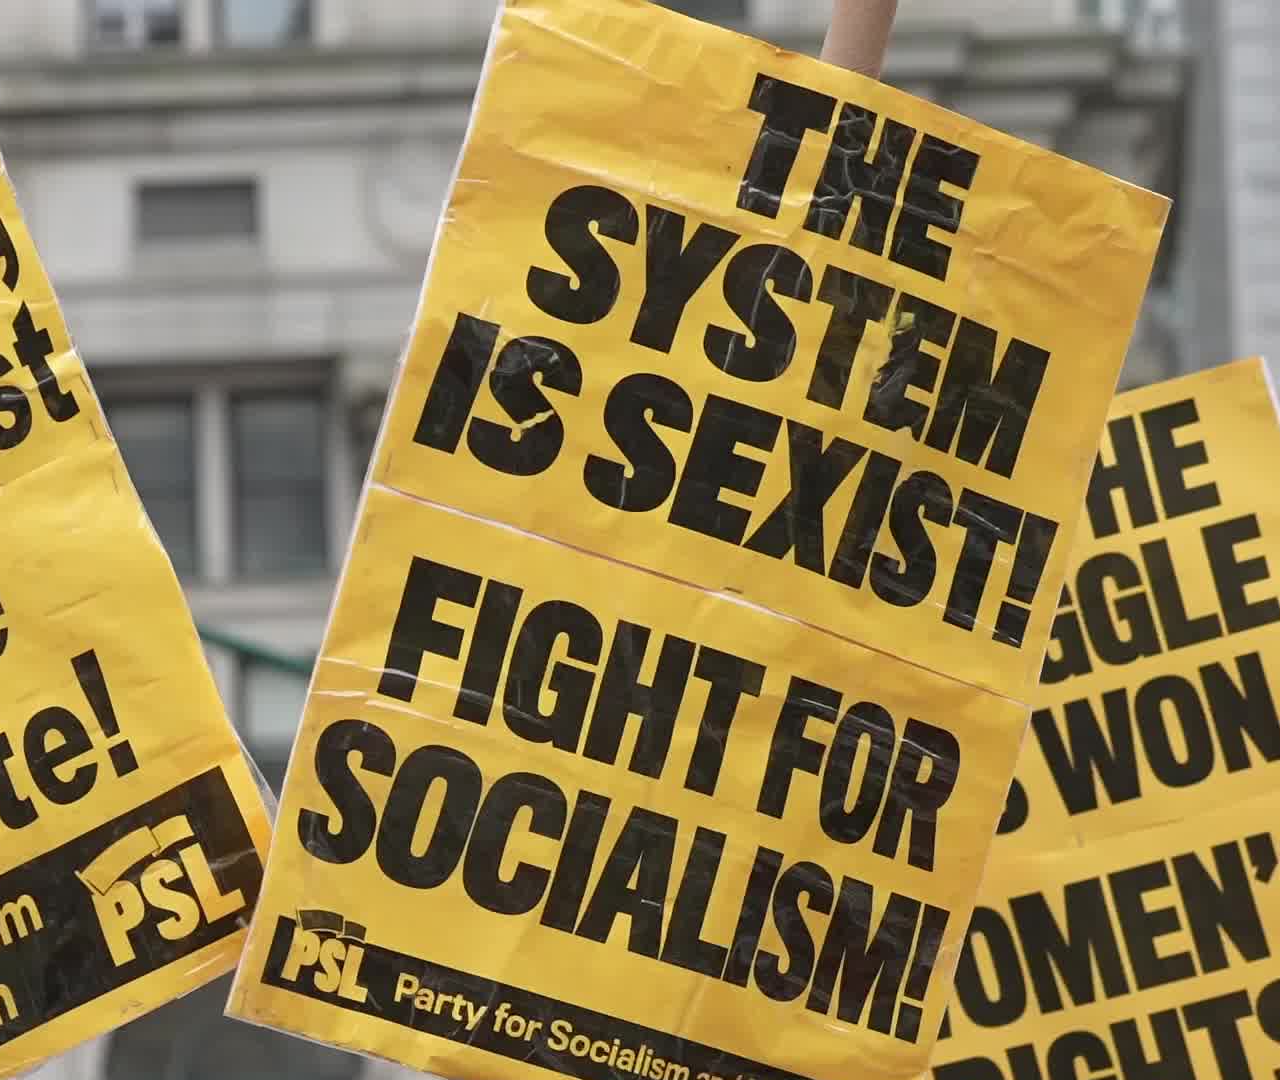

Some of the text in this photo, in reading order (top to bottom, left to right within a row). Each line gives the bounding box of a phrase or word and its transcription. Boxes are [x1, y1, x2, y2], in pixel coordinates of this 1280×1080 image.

[736, 73, 980, 281] THE
[526, 185, 1051, 478] SYSTEM
[413, 312, 1060, 645] IS SEXIST!
[1086, 398, 1221, 539] HE
[376, 556, 961, 870] FIGHT FOR
[92, 848, 246, 966] PSL
[280, 932, 368, 1003] PSL
[395, 972, 488, 1030] Party
[494, 1002, 541, 1042] for
[297, 720, 950, 1044] SOCIALISM!
